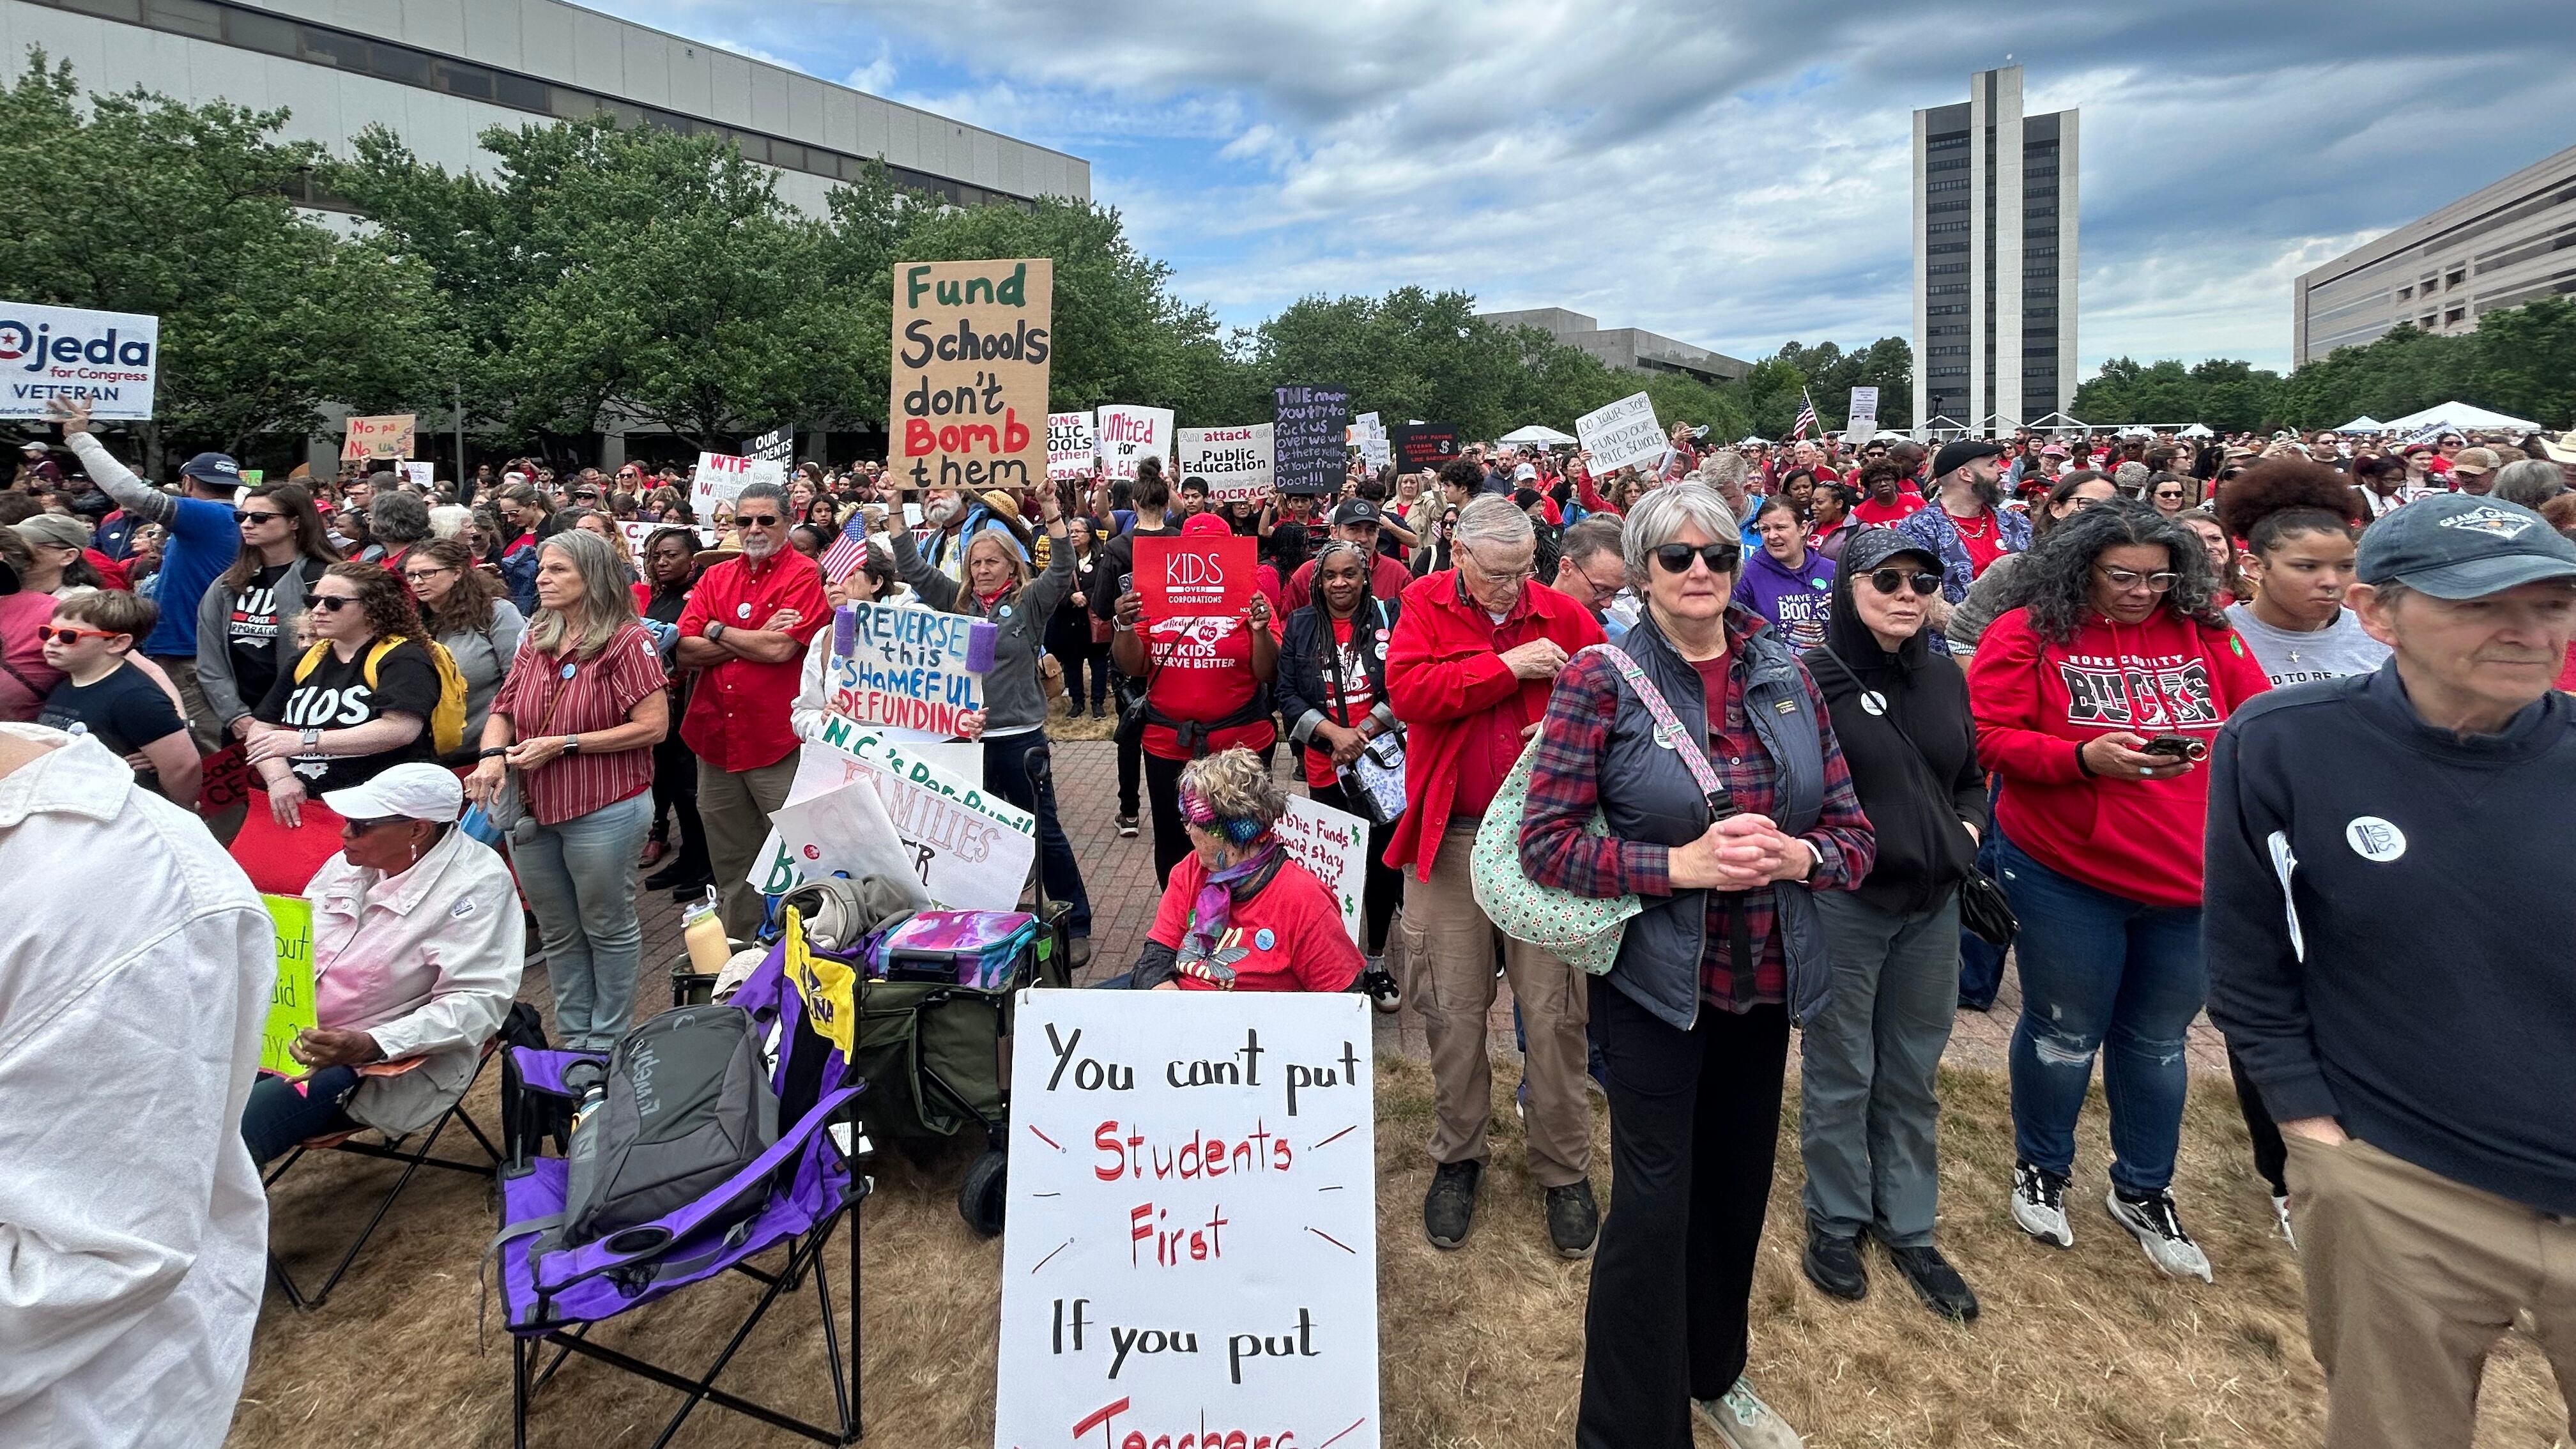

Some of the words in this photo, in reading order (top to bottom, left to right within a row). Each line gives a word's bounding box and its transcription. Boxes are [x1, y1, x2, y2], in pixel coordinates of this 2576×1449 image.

[907, 263, 1026, 309] Fund
[0, 320, 150, 372] Ojeda
[900, 319, 1049, 369] Schools
[50, 366, 75, 378] for
[77, 367, 148, 383] Congress
[13, 384, 119, 401] VETERAN
[903, 371, 1004, 417] don't
[1275, 387, 1311, 405] THE
[1314, 392, 1347, 402] more
[1049, 415, 1080, 427] ONG
[1277, 407, 1306, 421] you
[1307, 405, 1327, 418] try
[1329, 403, 1346, 417] to
[1579, 418, 1593, 434] DO
[1596, 406, 1625, 424] YOUR
[1625, 396, 1650, 413] JOBS
[353, 420, 374, 435] No
[905, 408, 1030, 457] Bomb
[1047, 425, 1084, 439] BLIC
[1204, 429, 1252, 442] attack
[1590, 430, 1628, 450] FUND
[1630, 422, 1653, 436] OUR
[755, 430, 779, 450] OUR
[1048, 437, 1092, 452] OOLS
[1117, 441, 1137, 455] for
[1309, 435, 1326, 445] we
[1439, 440, 1450, 454] $
[349, 440, 371, 459] No
[1048, 451, 1090, 464] gthen
[1202, 448, 1255, 462] Public
[1291, 445, 1321, 458] there
[711, 454, 753, 474] WTF
[1183, 459, 1266, 473] Education
[1276, 461, 1289, 473] at
[1588, 447, 1627, 471] PUBLIC
[909, 455, 1031, 487] them
[1051, 467, 1093, 480] CRAY
[1208, 485, 1269, 500] MOCRAC
[1167, 553, 1223, 585] KIDS
[1168, 595, 1222, 604] CORPORATIONS
[854, 602, 969, 657] REVERSE
[1200, 628, 1215, 638] NC
[880, 641, 942, 668] this
[1177, 643, 1216, 657] KIDS
[2068, 654, 2115, 667] HOKE
[2284, 672, 2307, 683] TO
[838, 688, 974, 739] DEFUNDING
[1316, 818, 1349, 850] Funds
[1311, 845, 1344, 878] stay
[1344, 894, 1354, 917] $
[1045, 1022, 1134, 1091] You
[1167, 1028, 1265, 1088] can't
[1286, 1041, 1361, 1116] put
[1094, 1115, 1292, 1181] Students
[1130, 1202, 1229, 1269] First
[1052, 1298, 1094, 1355] If
[1108, 1326, 1199, 1380] you
[1229, 1307, 1322, 1384] put
